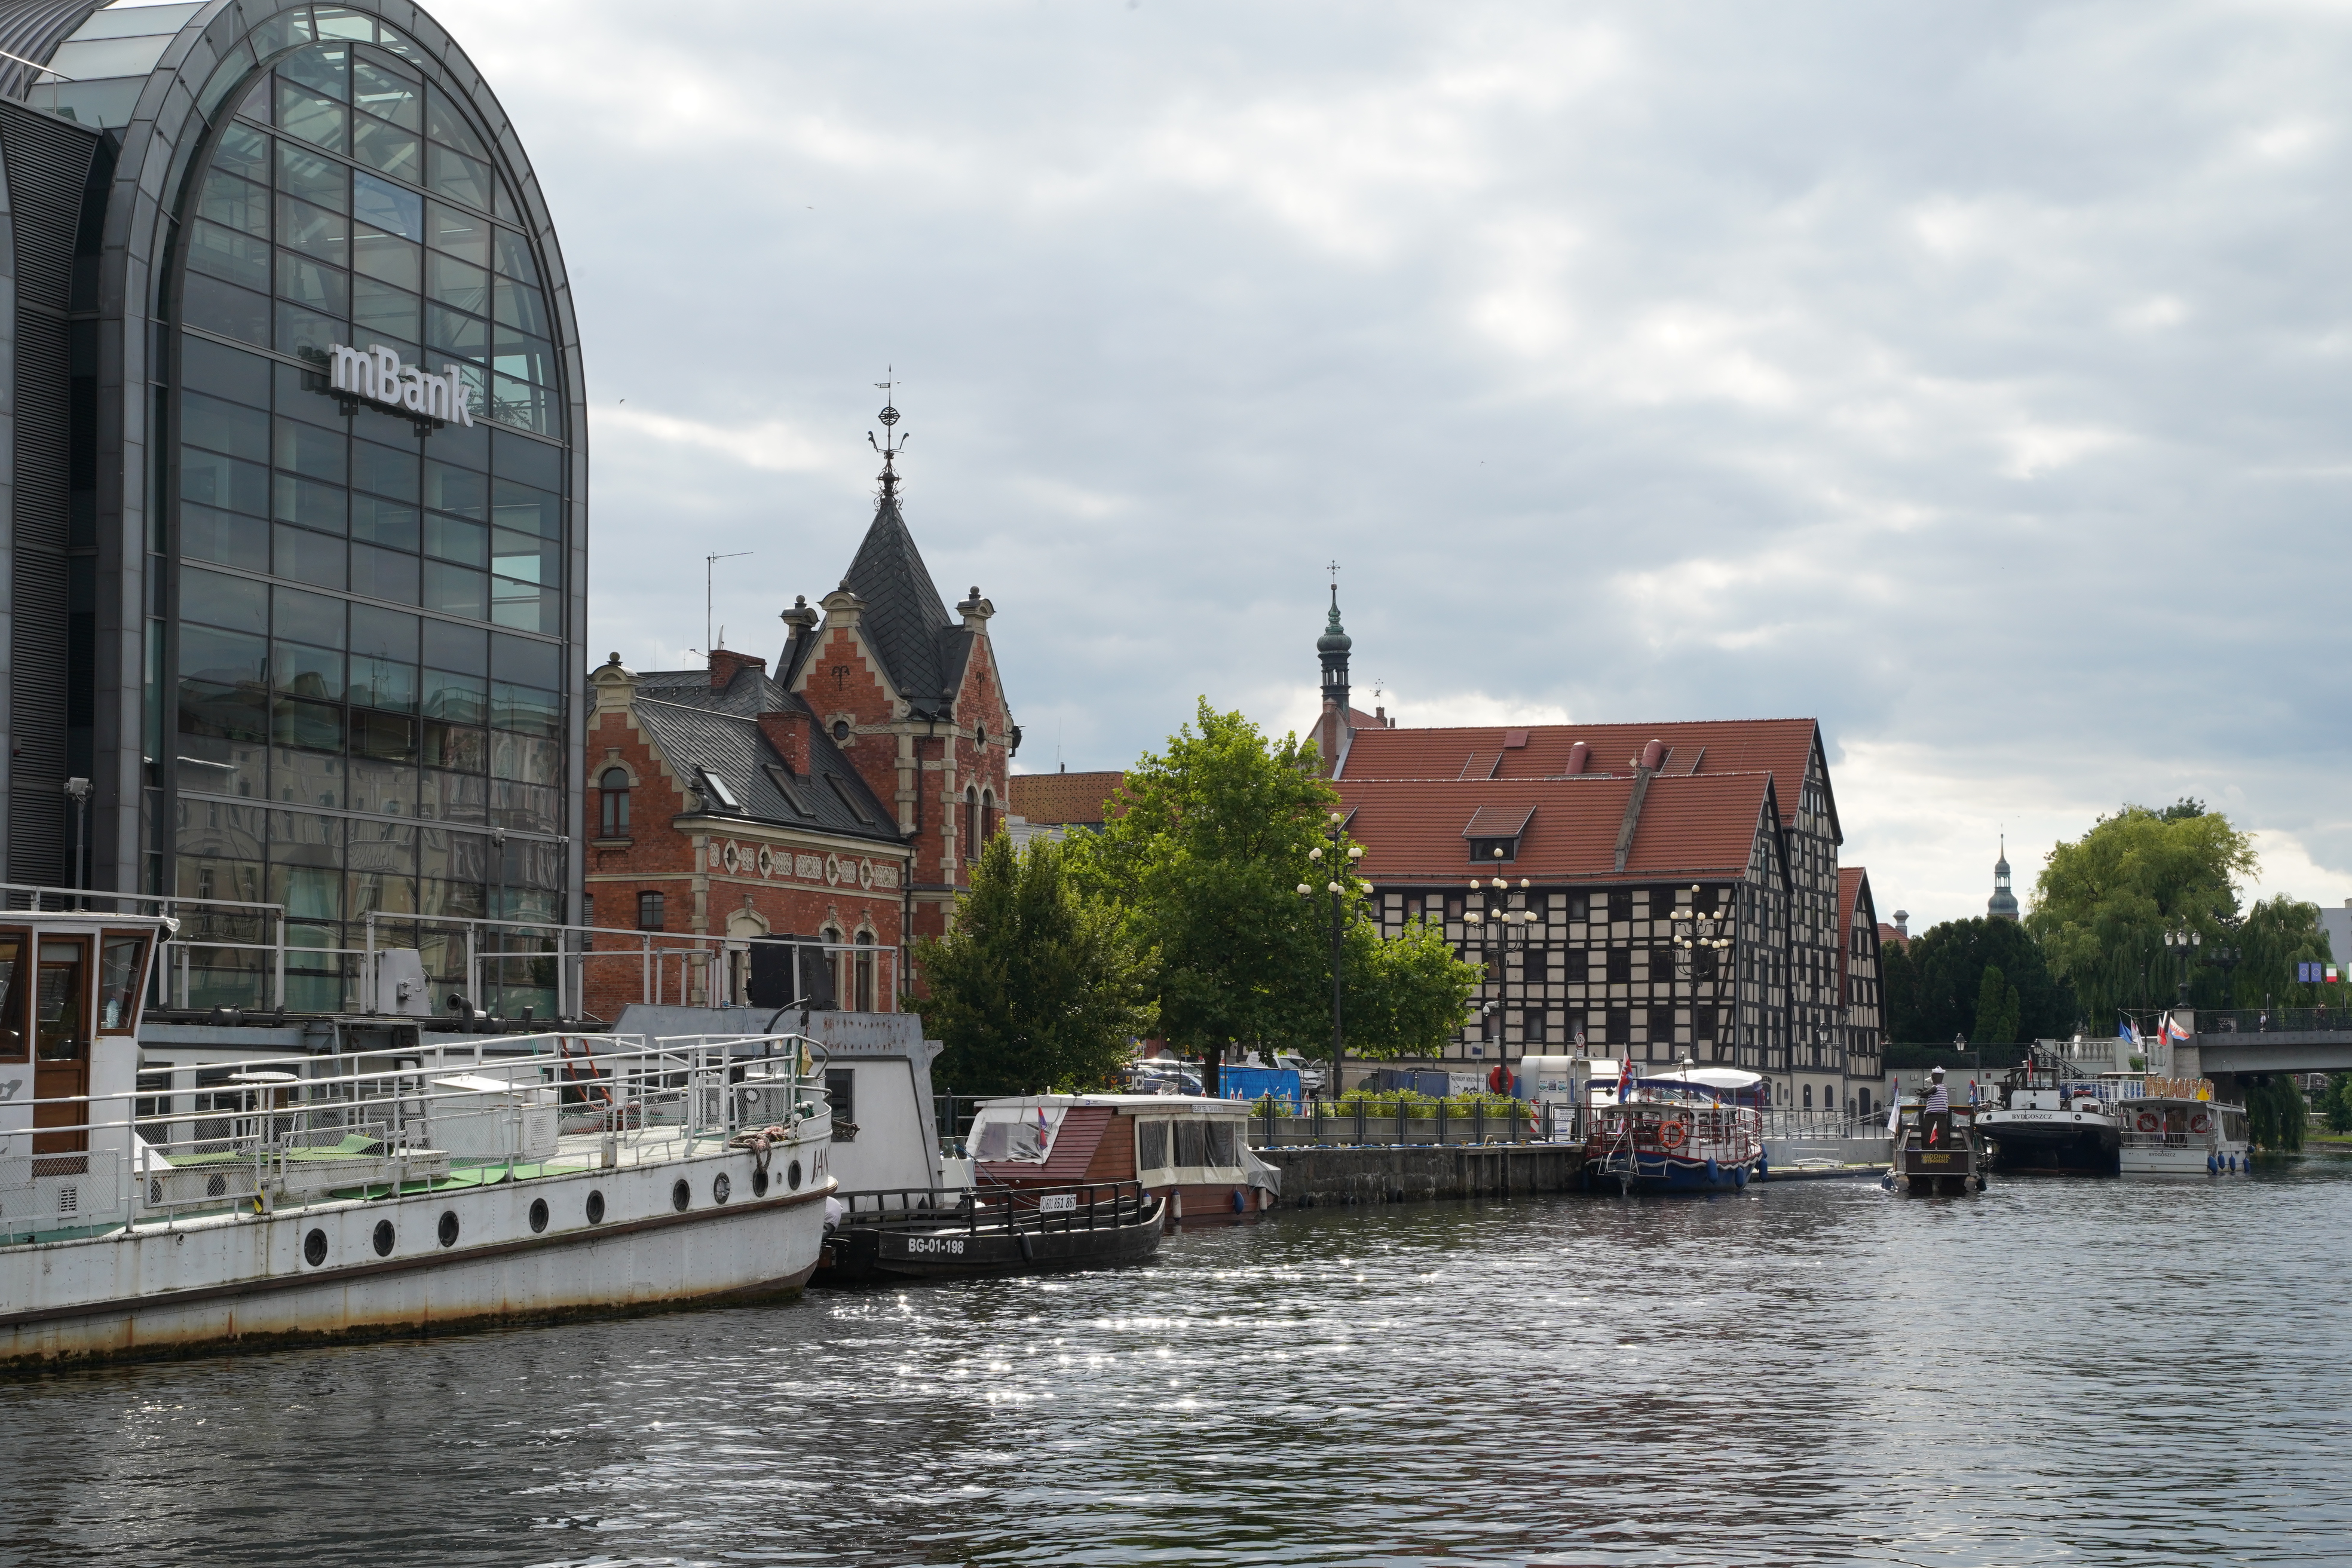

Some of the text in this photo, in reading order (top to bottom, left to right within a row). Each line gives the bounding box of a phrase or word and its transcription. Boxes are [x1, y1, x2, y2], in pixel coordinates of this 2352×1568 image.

[329, 344, 473, 427] mBank
[1054, 1198, 1064, 1209] 851
[1065, 1197, 1076, 1208] 867
[908, 1238, 964, 1254] BG-01-198
